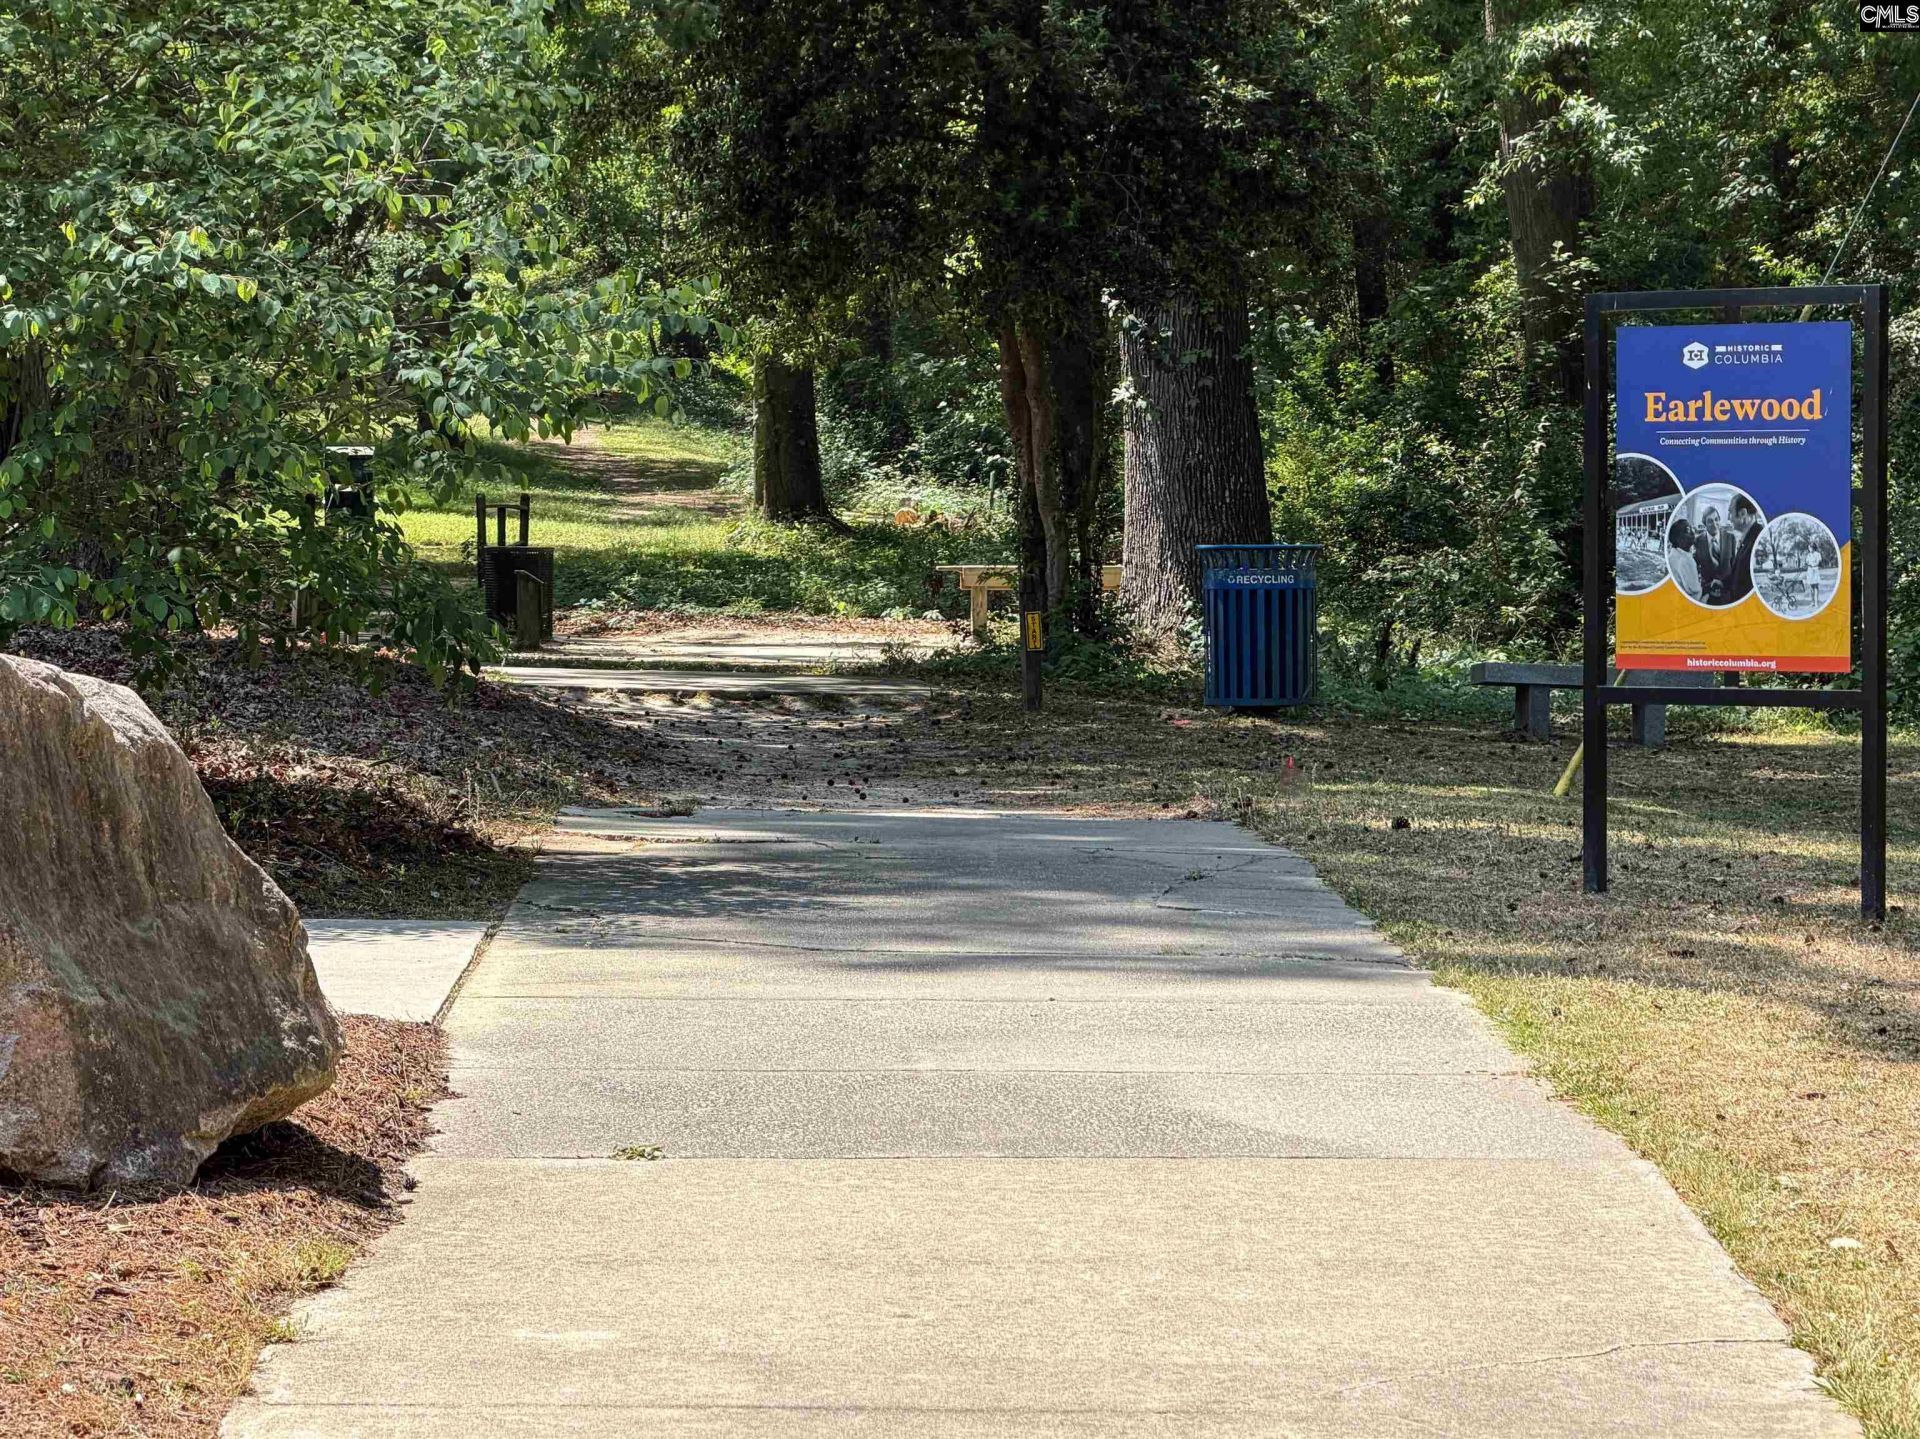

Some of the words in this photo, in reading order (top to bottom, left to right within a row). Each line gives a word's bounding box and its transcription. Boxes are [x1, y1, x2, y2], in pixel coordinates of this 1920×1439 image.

[1727, 344, 1770, 352] HISTORIC
[1714, 354, 1783, 365] COLUMBIA
[1644, 388, 1823, 422] Earlewood
[1659, 436, 1700, 447] Connecting
[1700, 436, 1748, 446] Communities
[1749, 436, 1777, 446] through
[1778, 435, 1806, 446] History
[1236, 575, 1295, 584] RECYCLING
[1687, 658, 1777, 669] historiccolumbia.org
